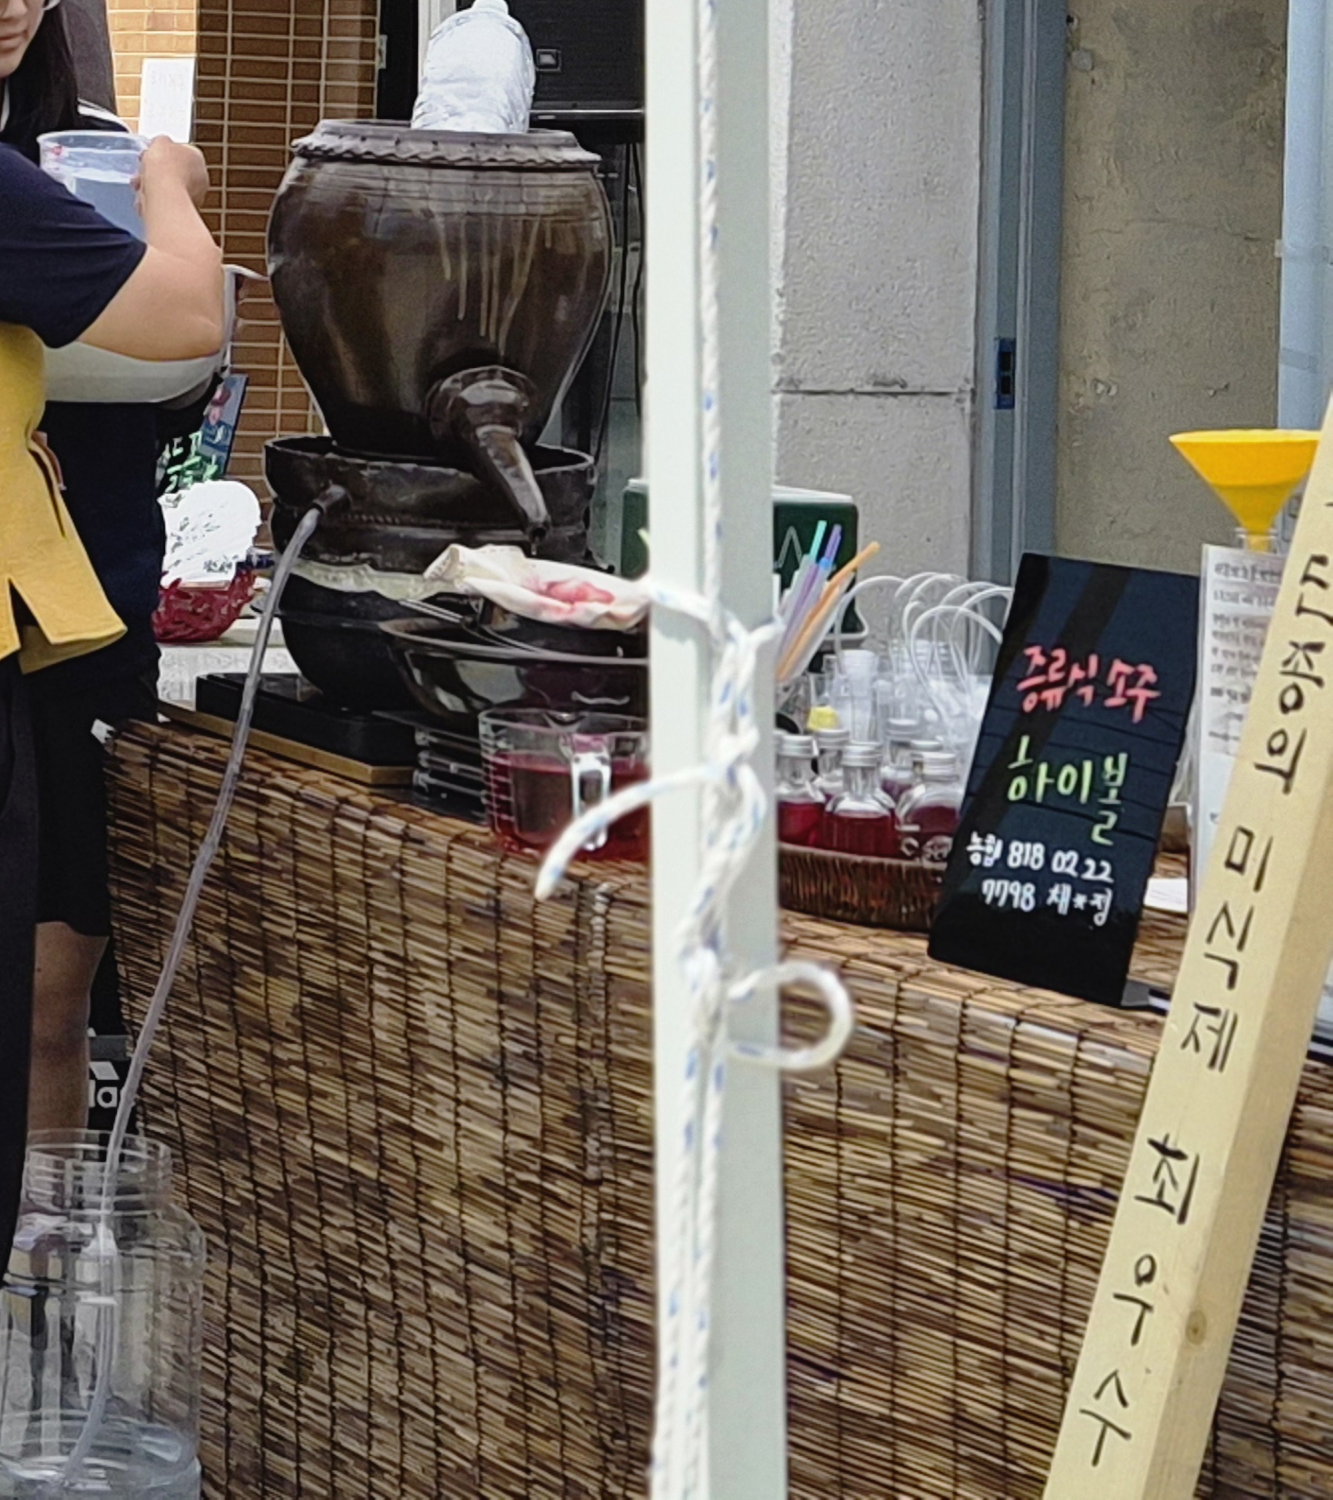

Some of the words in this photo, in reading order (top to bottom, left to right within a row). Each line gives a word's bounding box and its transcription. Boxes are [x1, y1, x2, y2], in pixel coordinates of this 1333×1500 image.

[1018, 646, 1098, 713] 증류식
[1104, 659, 1161, 723] 소주
[1008, 735, 1128, 846] 하이볼
[1007, 840, 1045, 870] 818
[1181, 826, 1274, 1072] 미각제
[1079, 1134, 1200, 1466] 최우수
